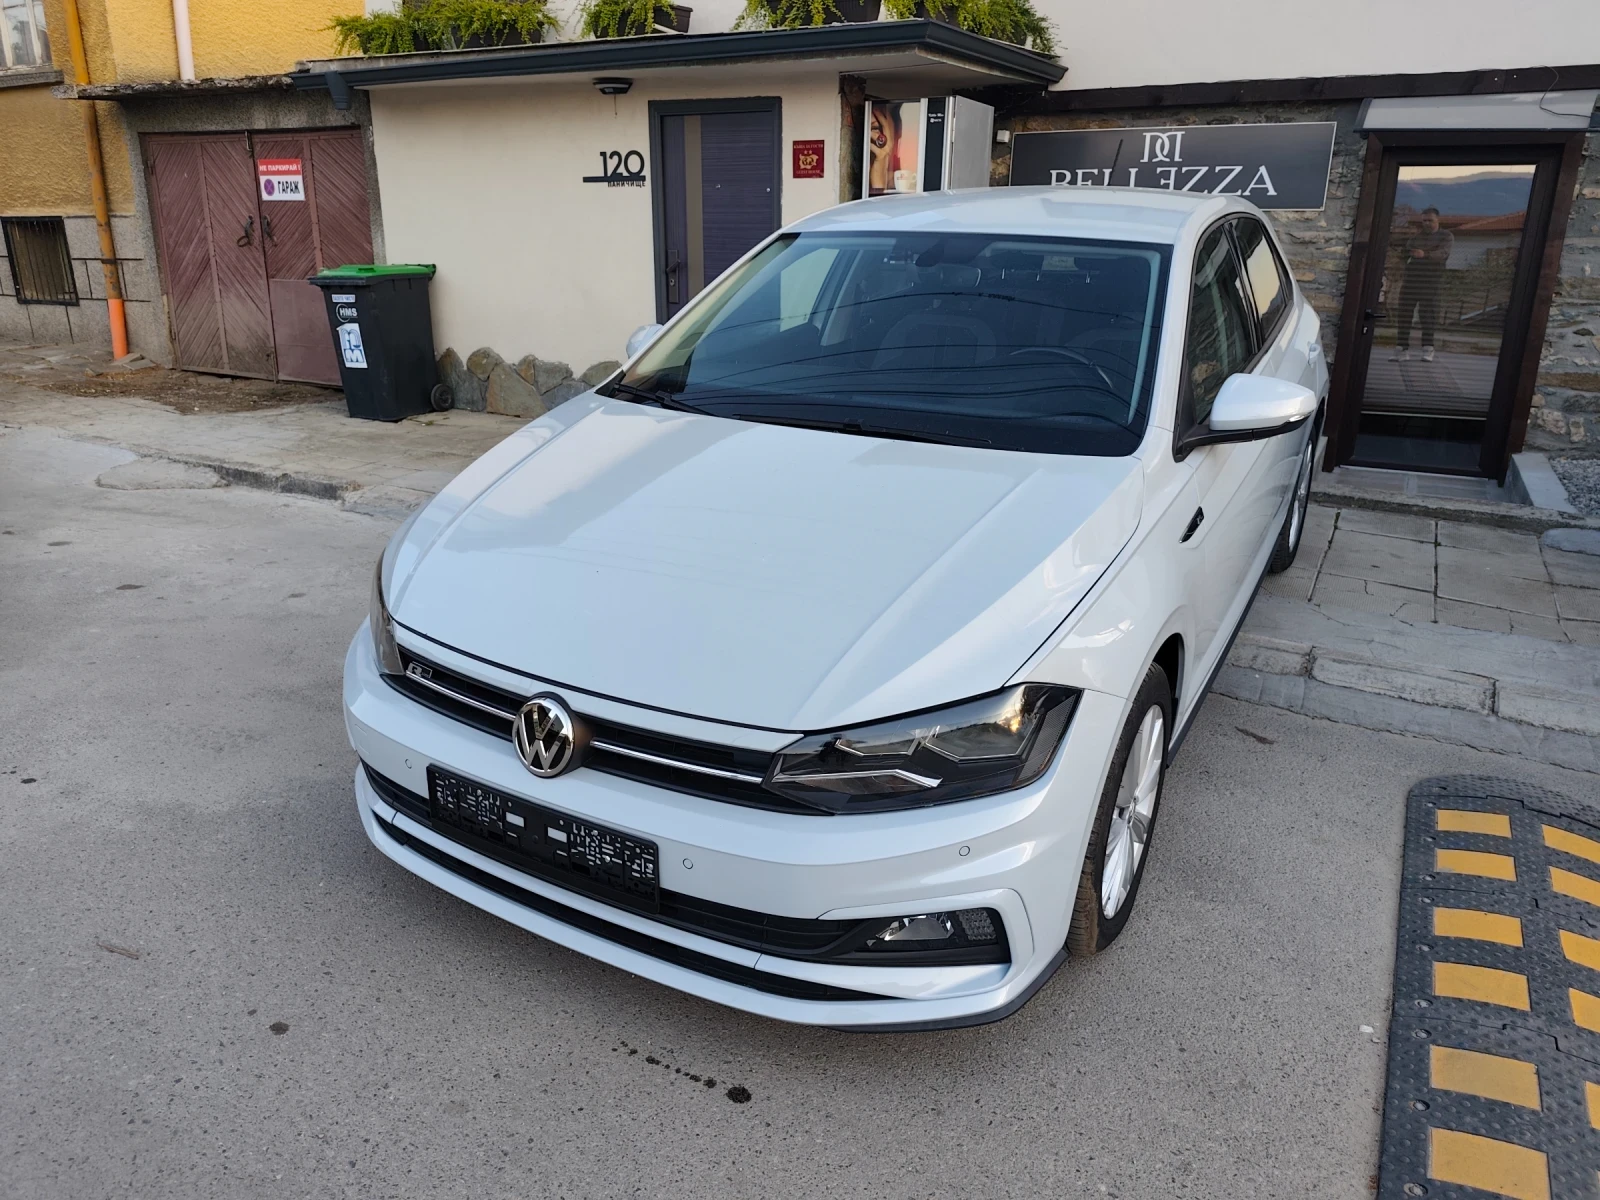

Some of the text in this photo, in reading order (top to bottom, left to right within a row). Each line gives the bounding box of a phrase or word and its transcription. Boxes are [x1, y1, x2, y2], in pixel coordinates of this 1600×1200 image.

[259, 164, 267, 172] НЕ
[268, 163, 297, 172] ПАРКИРАЙ
[600, 149, 645, 178] 120
[277, 180, 301, 195] ГАРАЖ
[607, 180, 646, 188] ПАНИЧИЩЕ
[339, 307, 358, 317] HMS
